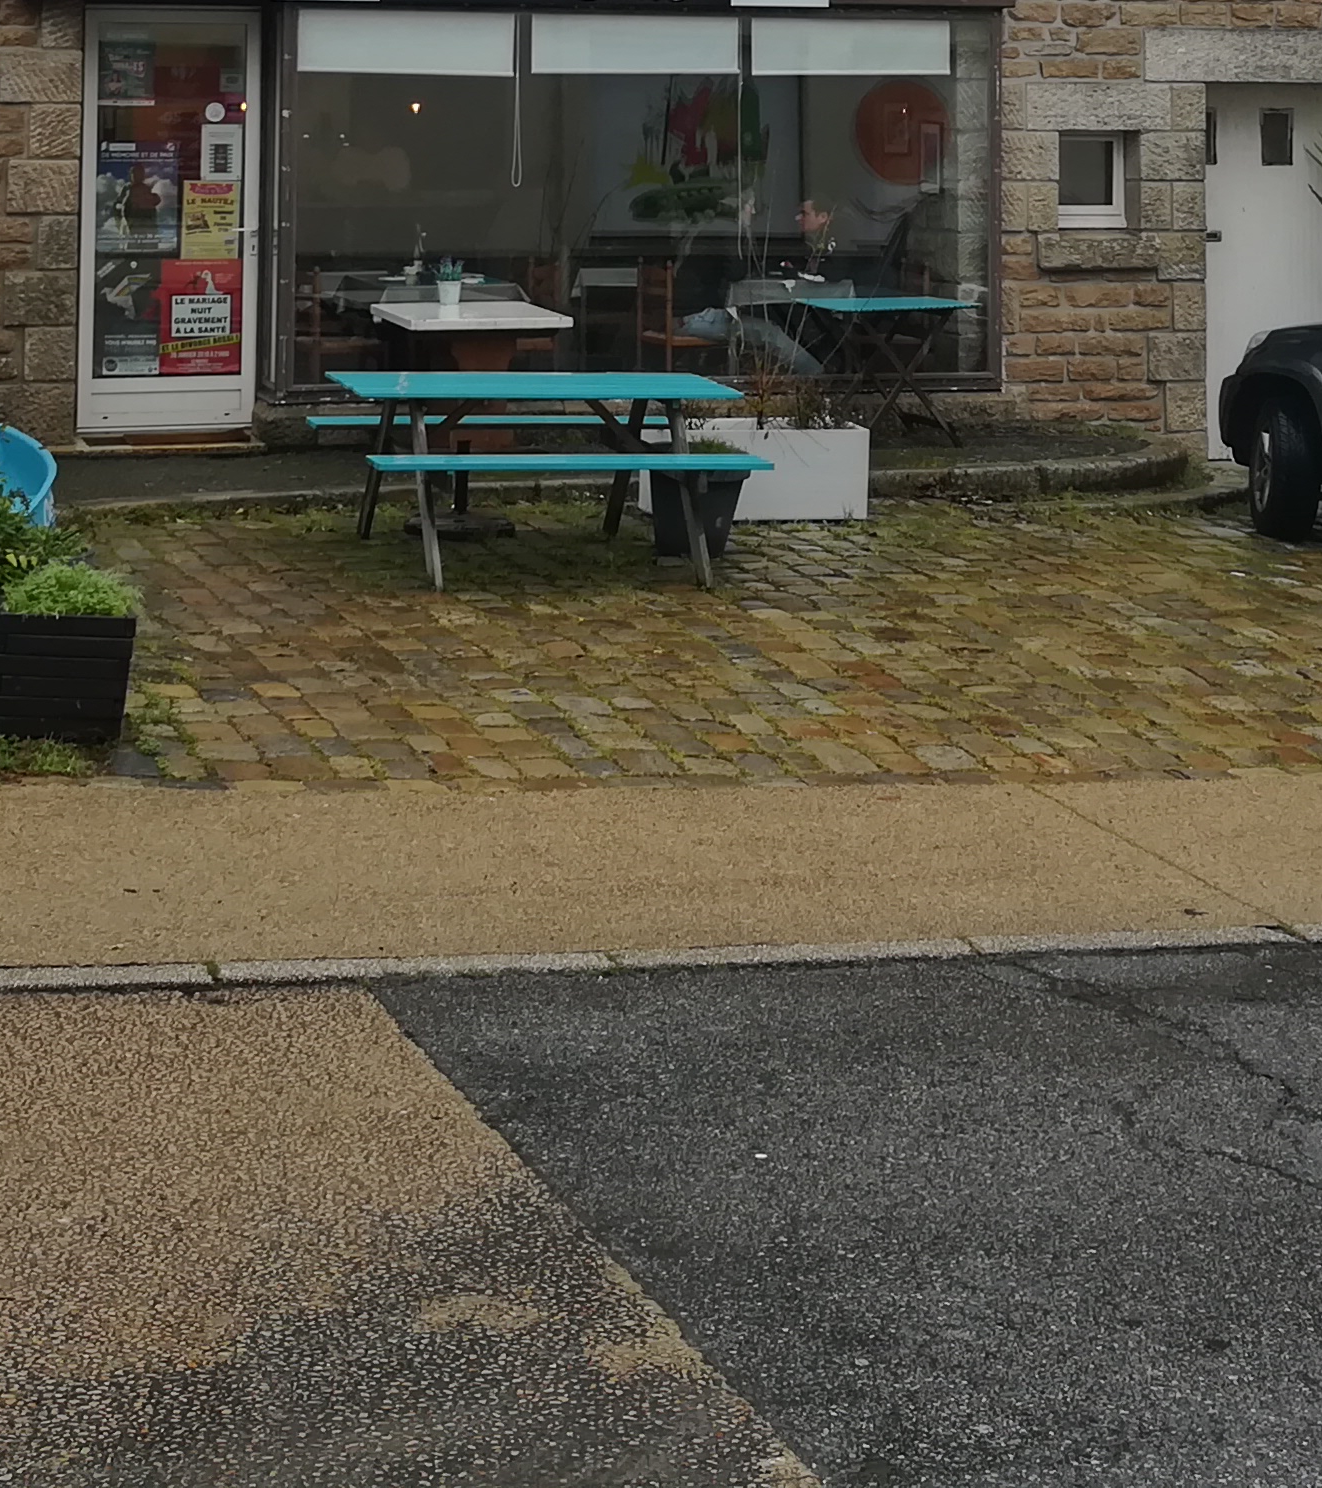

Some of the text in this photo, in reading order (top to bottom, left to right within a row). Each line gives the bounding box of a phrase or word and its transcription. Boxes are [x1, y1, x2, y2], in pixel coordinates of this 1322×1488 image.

[174, 297, 228, 305] LE MARIAGE
[174, 316, 229, 324] GRAVEMENT
